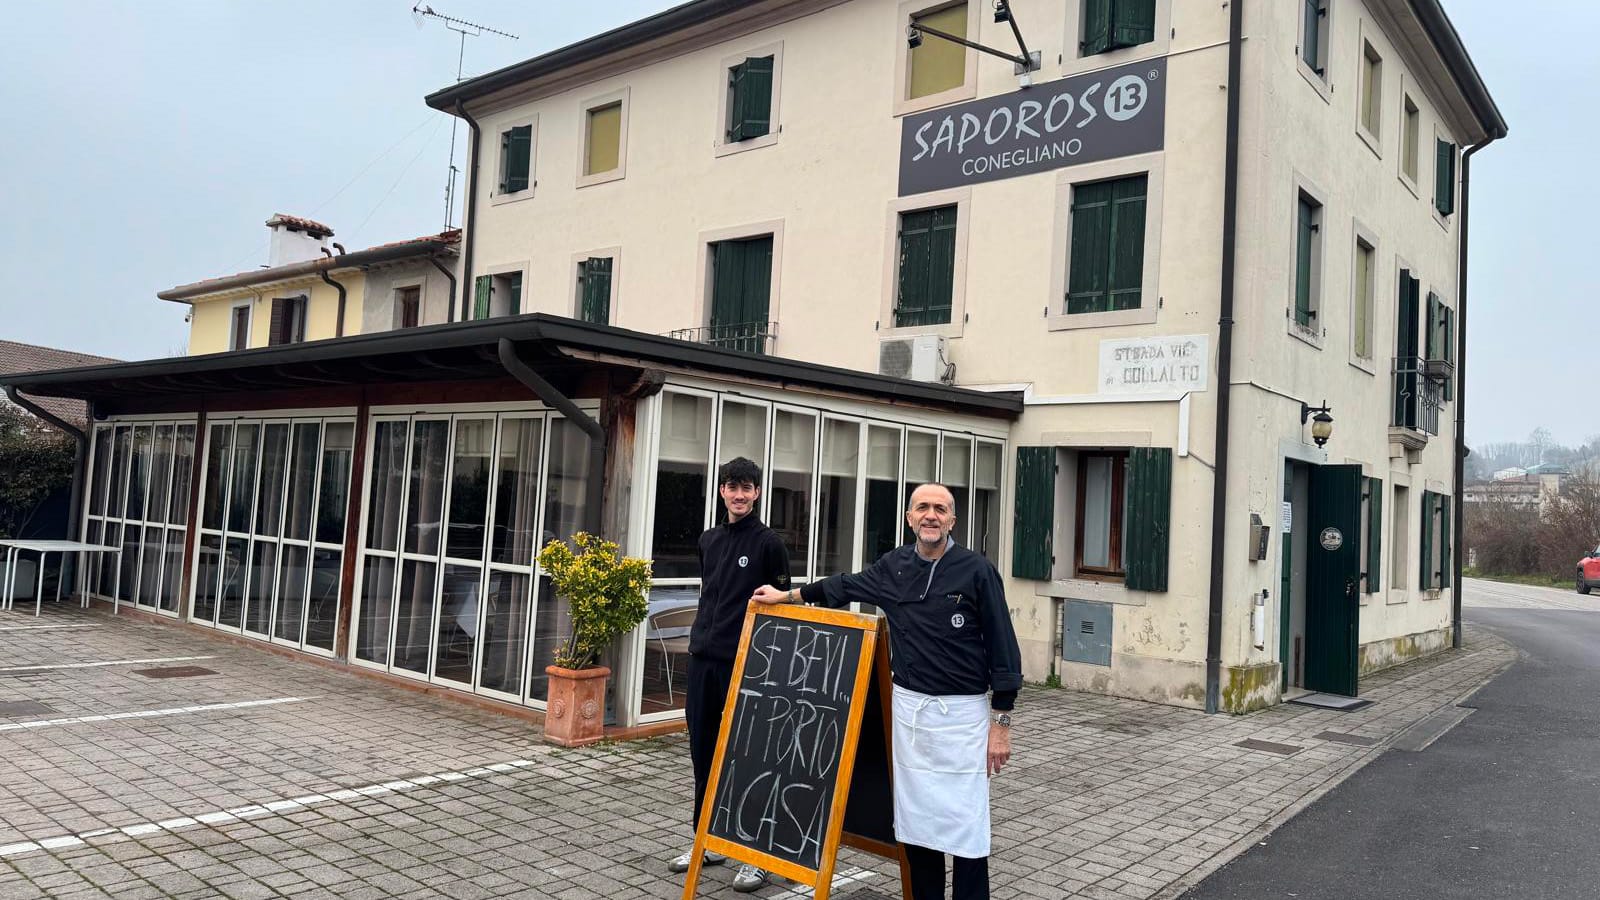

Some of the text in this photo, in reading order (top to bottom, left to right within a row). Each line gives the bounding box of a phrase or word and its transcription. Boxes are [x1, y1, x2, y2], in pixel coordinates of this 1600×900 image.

[962, 138, 1082, 176] CONEGLIANO
[1114, 345, 1165, 361] STRADA
[1123, 365, 1199, 384] COLLALTO
[744, 620, 792, 686] SE
[763, 694, 838, 780] PORTO
[712, 759, 828, 869] A CASA
